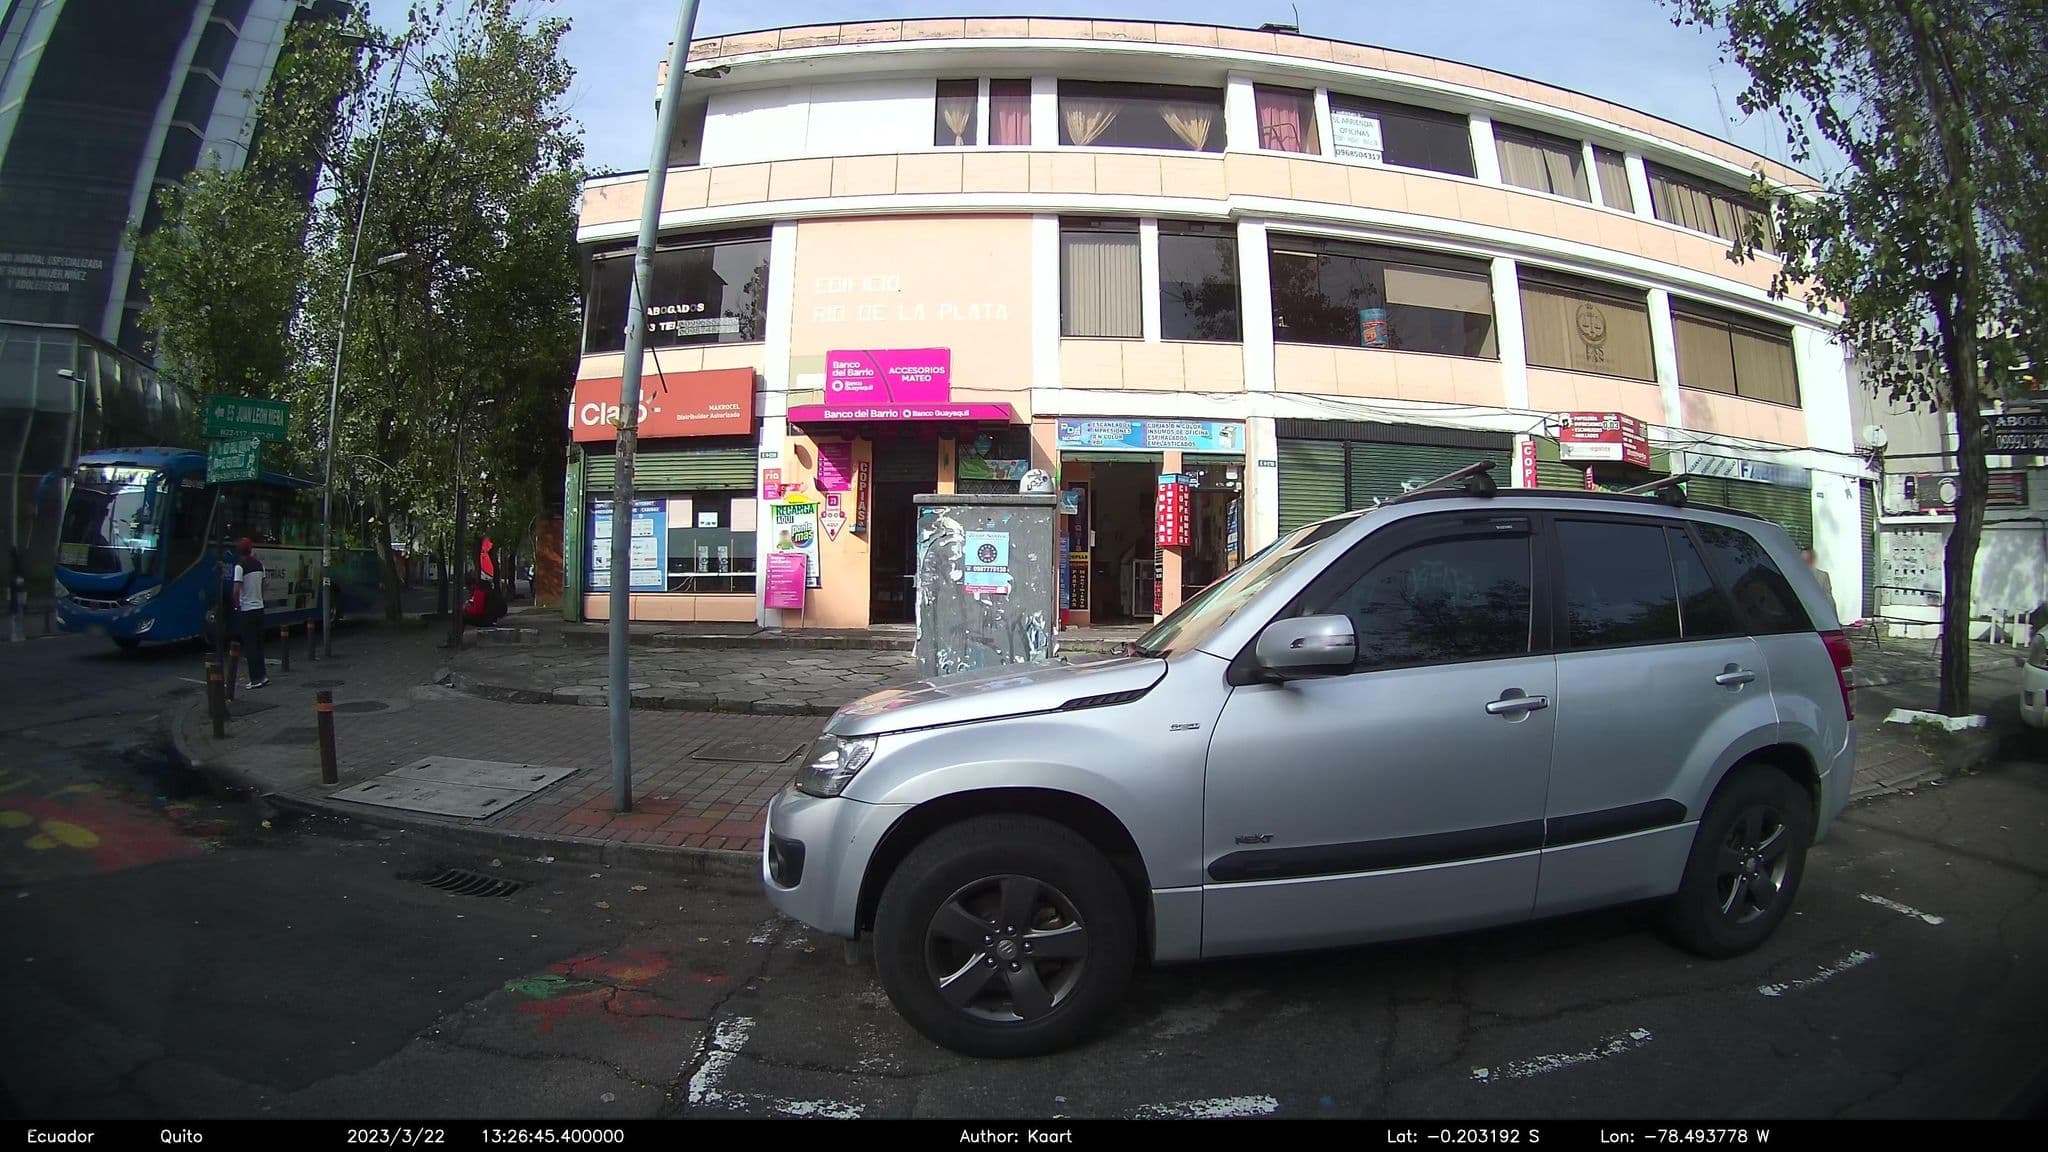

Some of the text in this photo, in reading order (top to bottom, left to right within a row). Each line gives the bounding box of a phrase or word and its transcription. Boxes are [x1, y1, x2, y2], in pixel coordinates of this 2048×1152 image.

[647, 302, 705, 316] ABOGADOS
[897, 304, 925, 320] LA
[937, 304, 1008, 320] PLATA
[832, 361, 860, 369] Banco
[832, 368, 874, 377] del Barrio
[889, 367, 945, 375] ACCESORIOS
[901, 374, 932, 382] MATEO
[708, 403, 741, 411] MAKROCEL
[580, 402, 648, 426] Clao
[676, 413, 709, 421] Distribuidor
[824, 410, 853, 419] Banco
[854, 409, 869, 418] del
[870, 409, 898, 418] Barrio
[935, 409, 970, 418] Guayaquil
[860, 462, 868, 520] COPIAS
[776, 504, 815, 515] RECARGA
[1166, 483, 1174, 543] INTERNET
